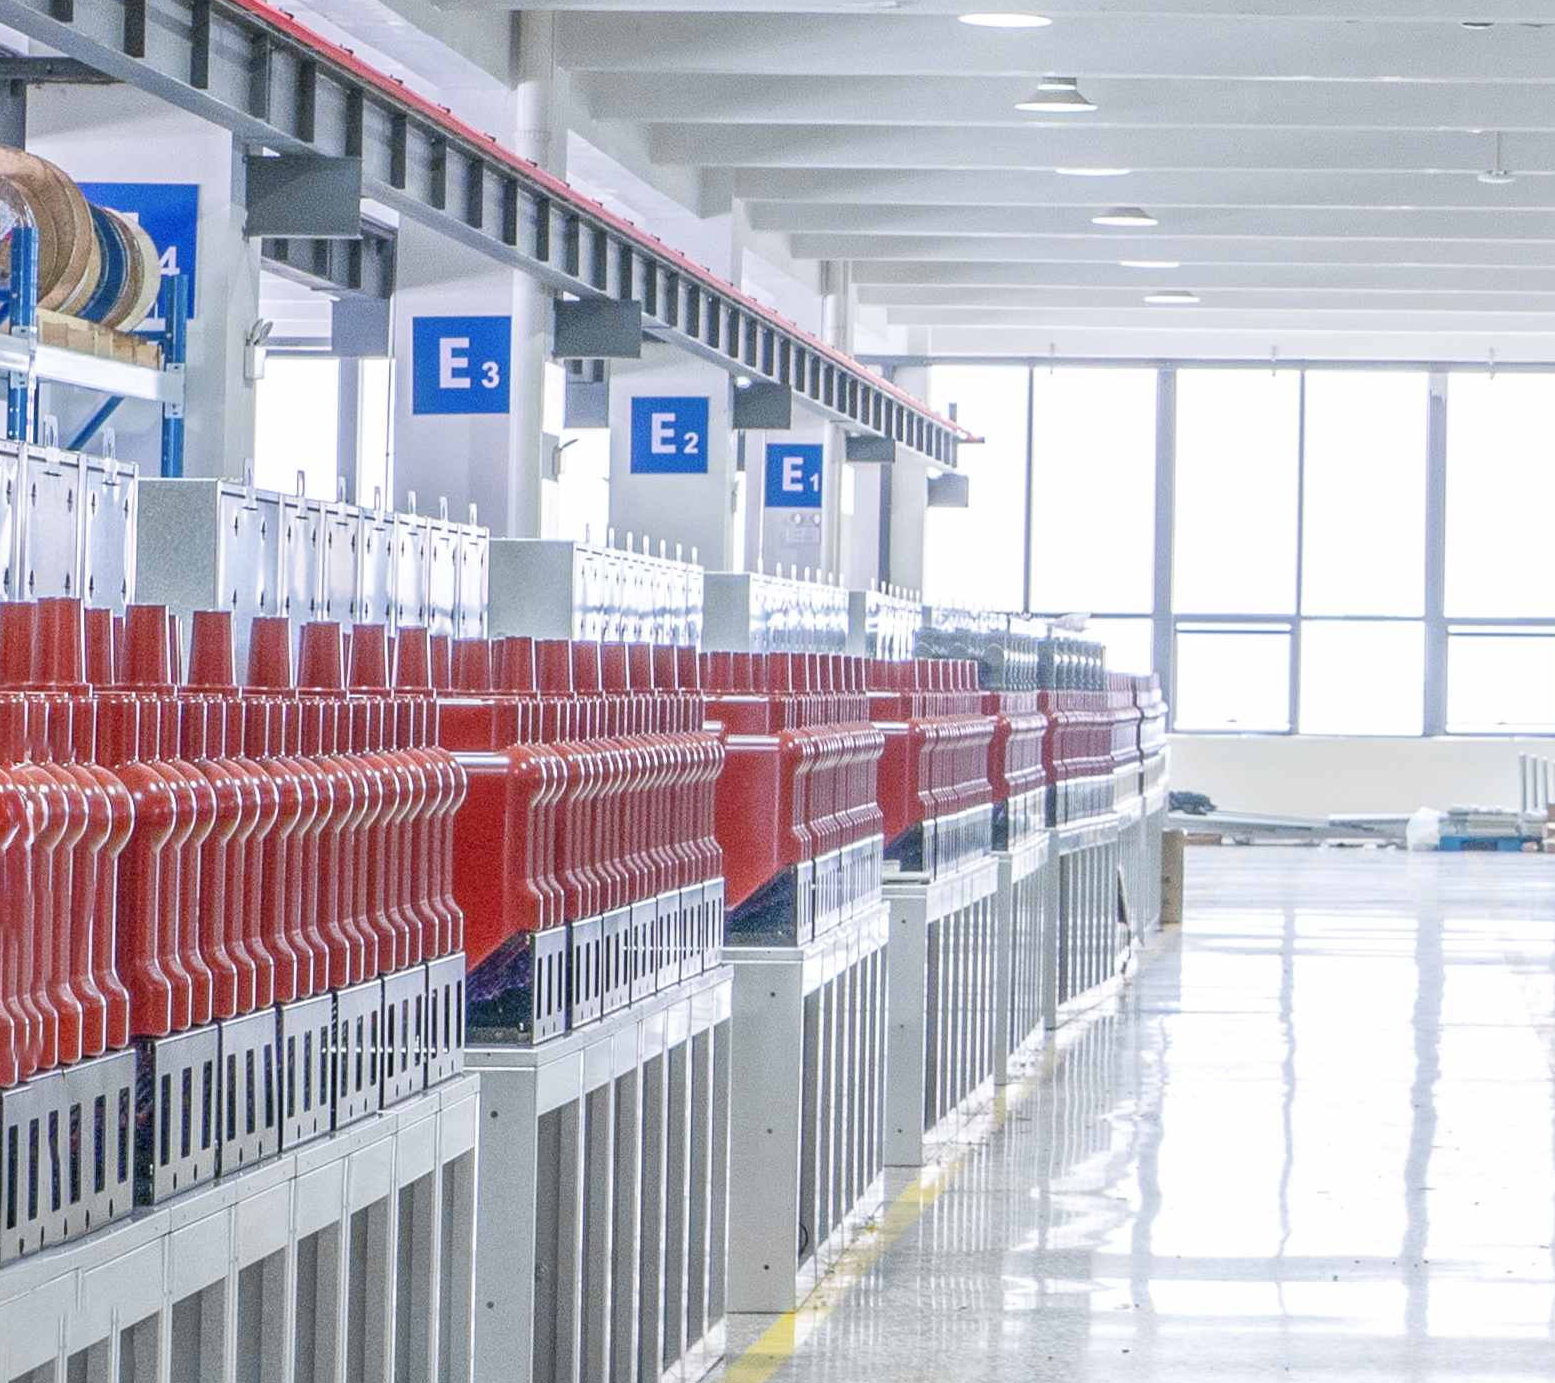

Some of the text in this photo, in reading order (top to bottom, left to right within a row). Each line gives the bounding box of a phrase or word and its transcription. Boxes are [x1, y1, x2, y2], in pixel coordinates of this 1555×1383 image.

[439, 337, 501, 390] E3
[651, 412, 700, 455] E2
[782, 456, 820, 493] E1
